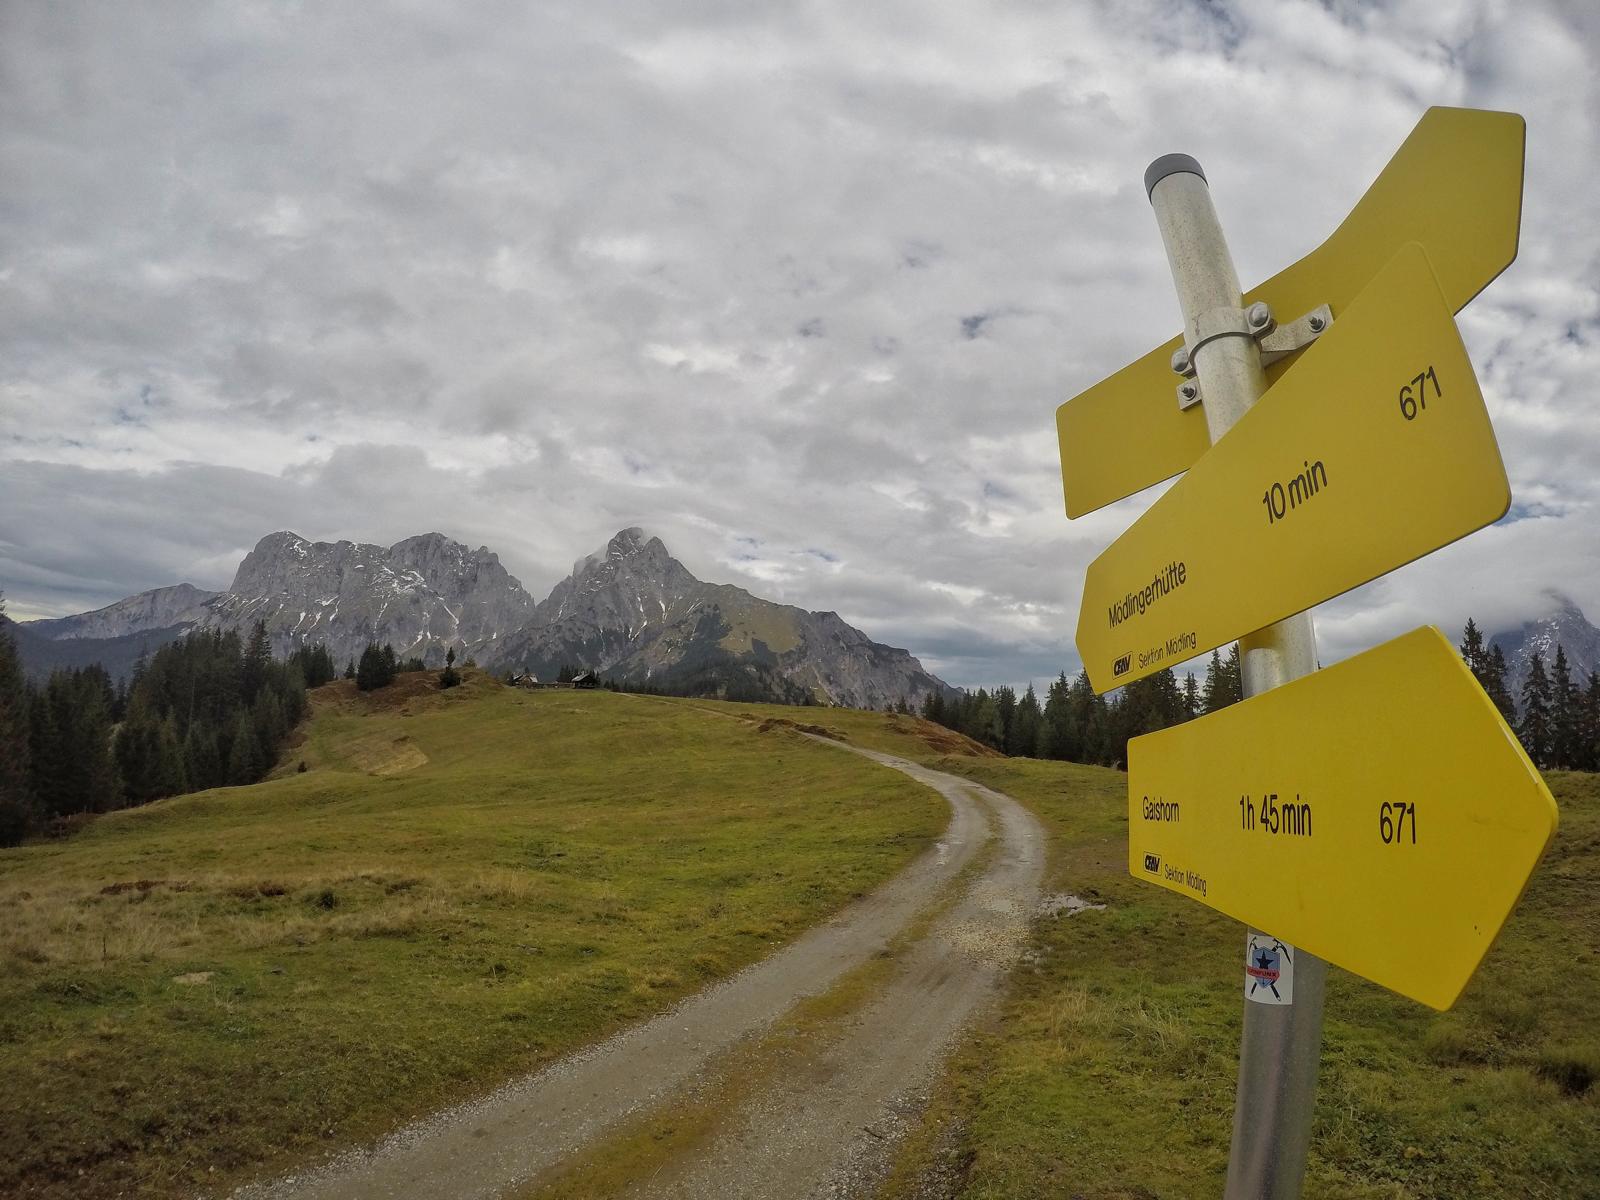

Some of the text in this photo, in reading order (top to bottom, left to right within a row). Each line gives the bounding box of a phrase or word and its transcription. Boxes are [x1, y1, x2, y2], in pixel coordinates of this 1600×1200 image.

[1399, 365, 1442, 421] 671
[1108, 560, 1187, 629] Mödlingerhütte
[1138, 647, 1164, 670] Sektion
[1165, 631, 1197, 658] Mödling
[1142, 796, 1180, 823] Gaishorn
[1239, 795, 1255, 831] 1h
[1379, 801, 1416, 845] 671
[1164, 863, 1185, 885] Sektion
[1186, 870, 1207, 897] Mödling
